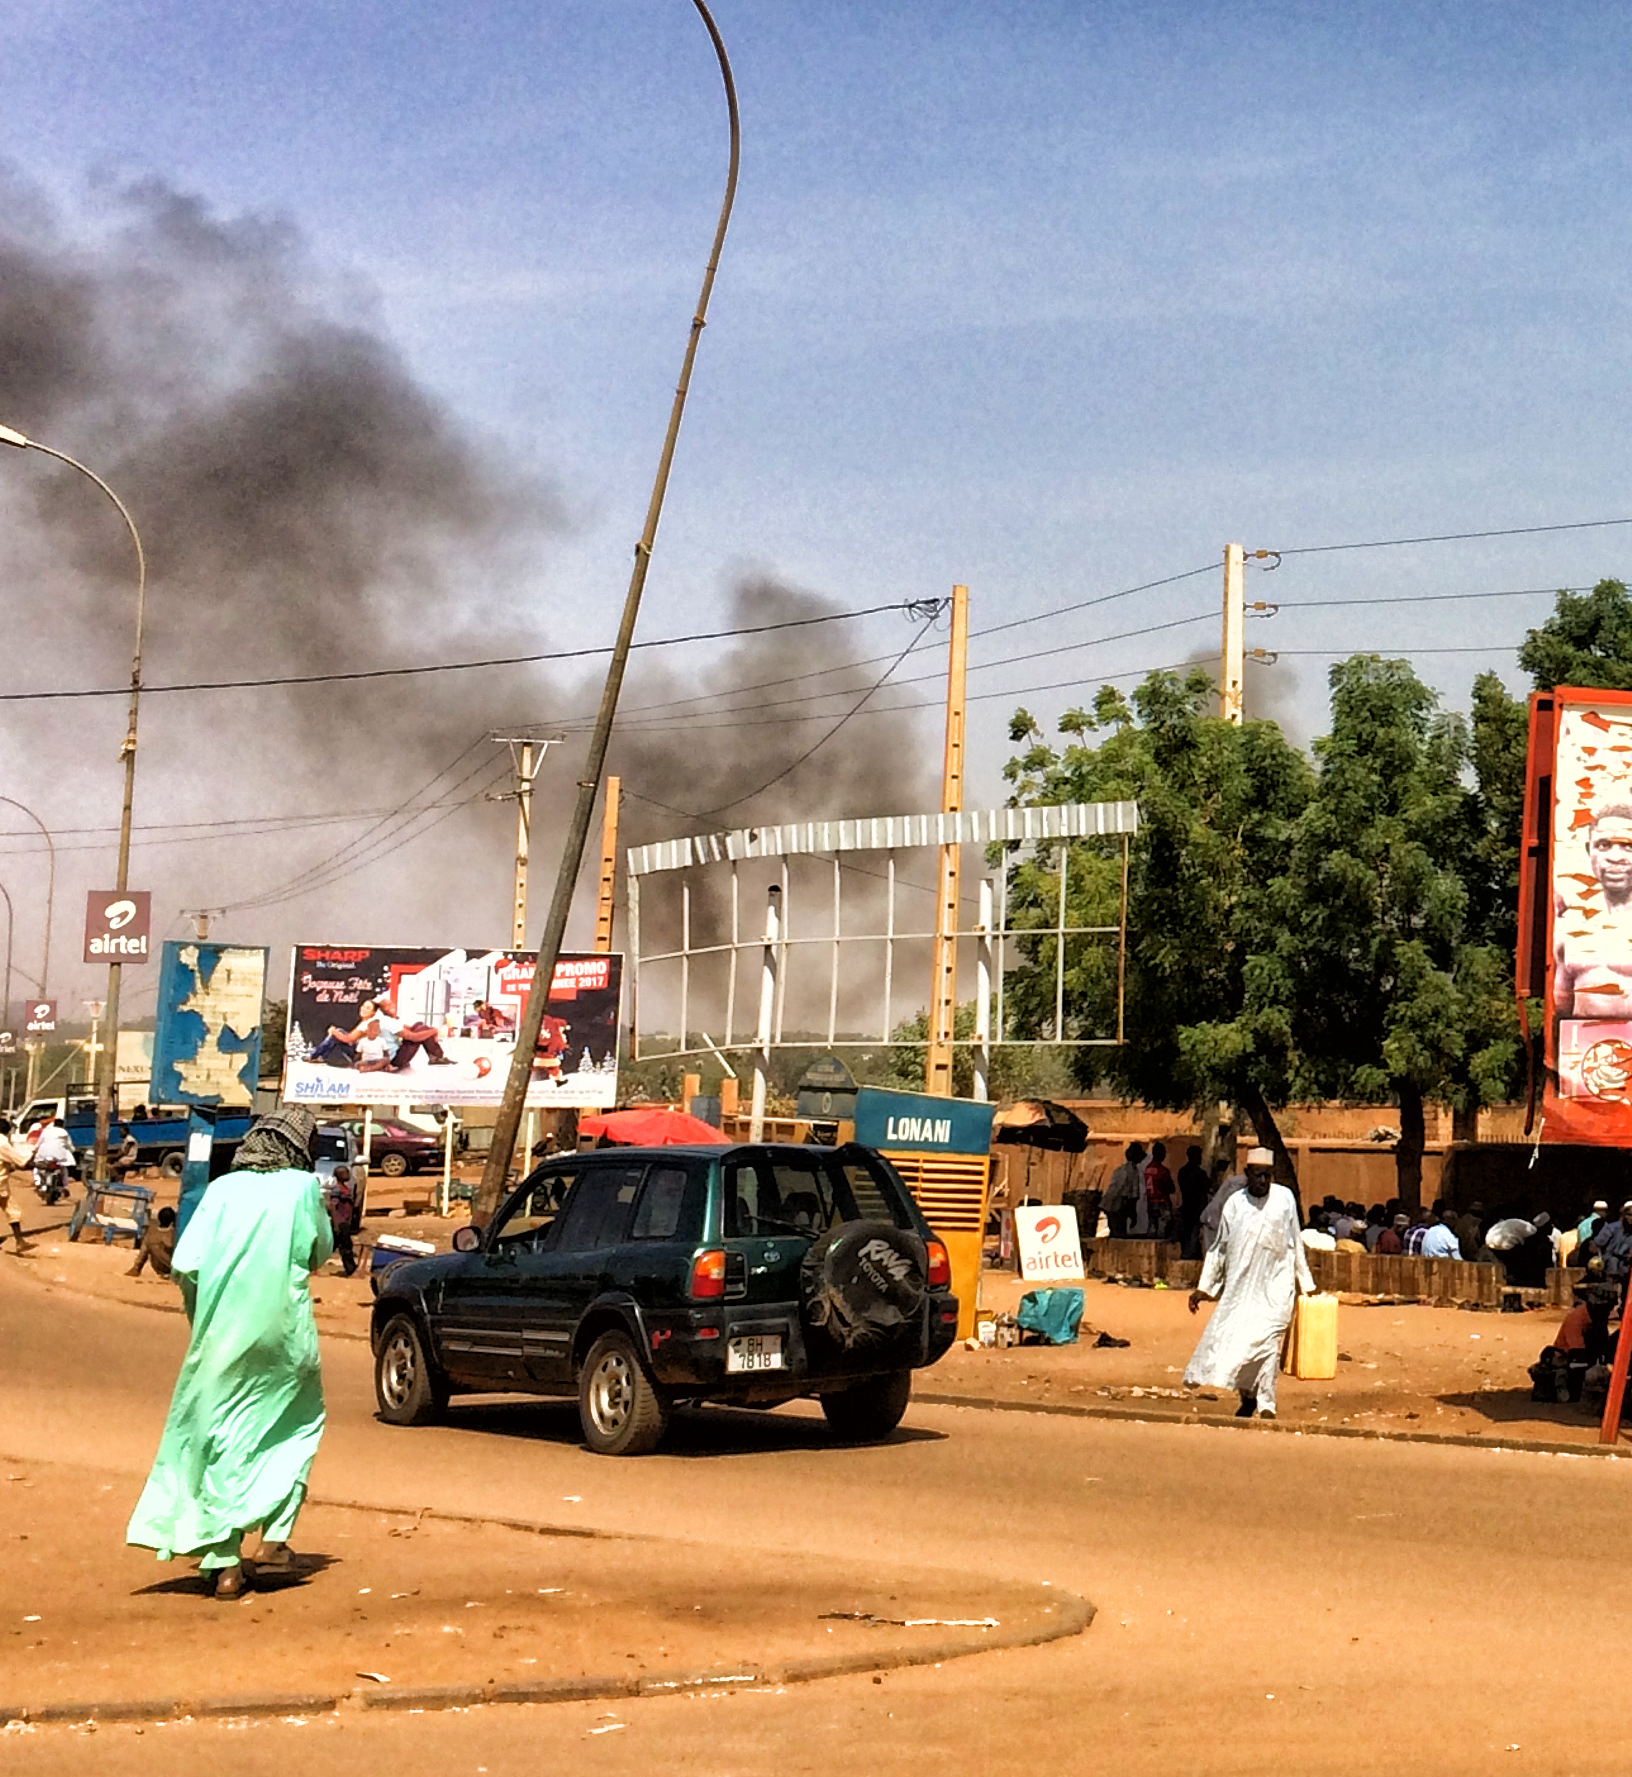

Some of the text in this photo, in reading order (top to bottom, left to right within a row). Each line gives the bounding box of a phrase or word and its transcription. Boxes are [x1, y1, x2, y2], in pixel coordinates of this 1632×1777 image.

[89, 934, 147, 954] airtel
[302, 948, 370, 962] SHARP
[503, 961, 607, 980] GRAN PROMO
[578, 976, 604, 988] 2017
[27, 1020, 55, 1031] airtel
[887, 1116, 951, 1143] LONANI
[857, 1239, 913, 1281] RAV4
[1025, 1250, 1080, 1272] airtel
[858, 1256, 889, 1294] TOYOTA
